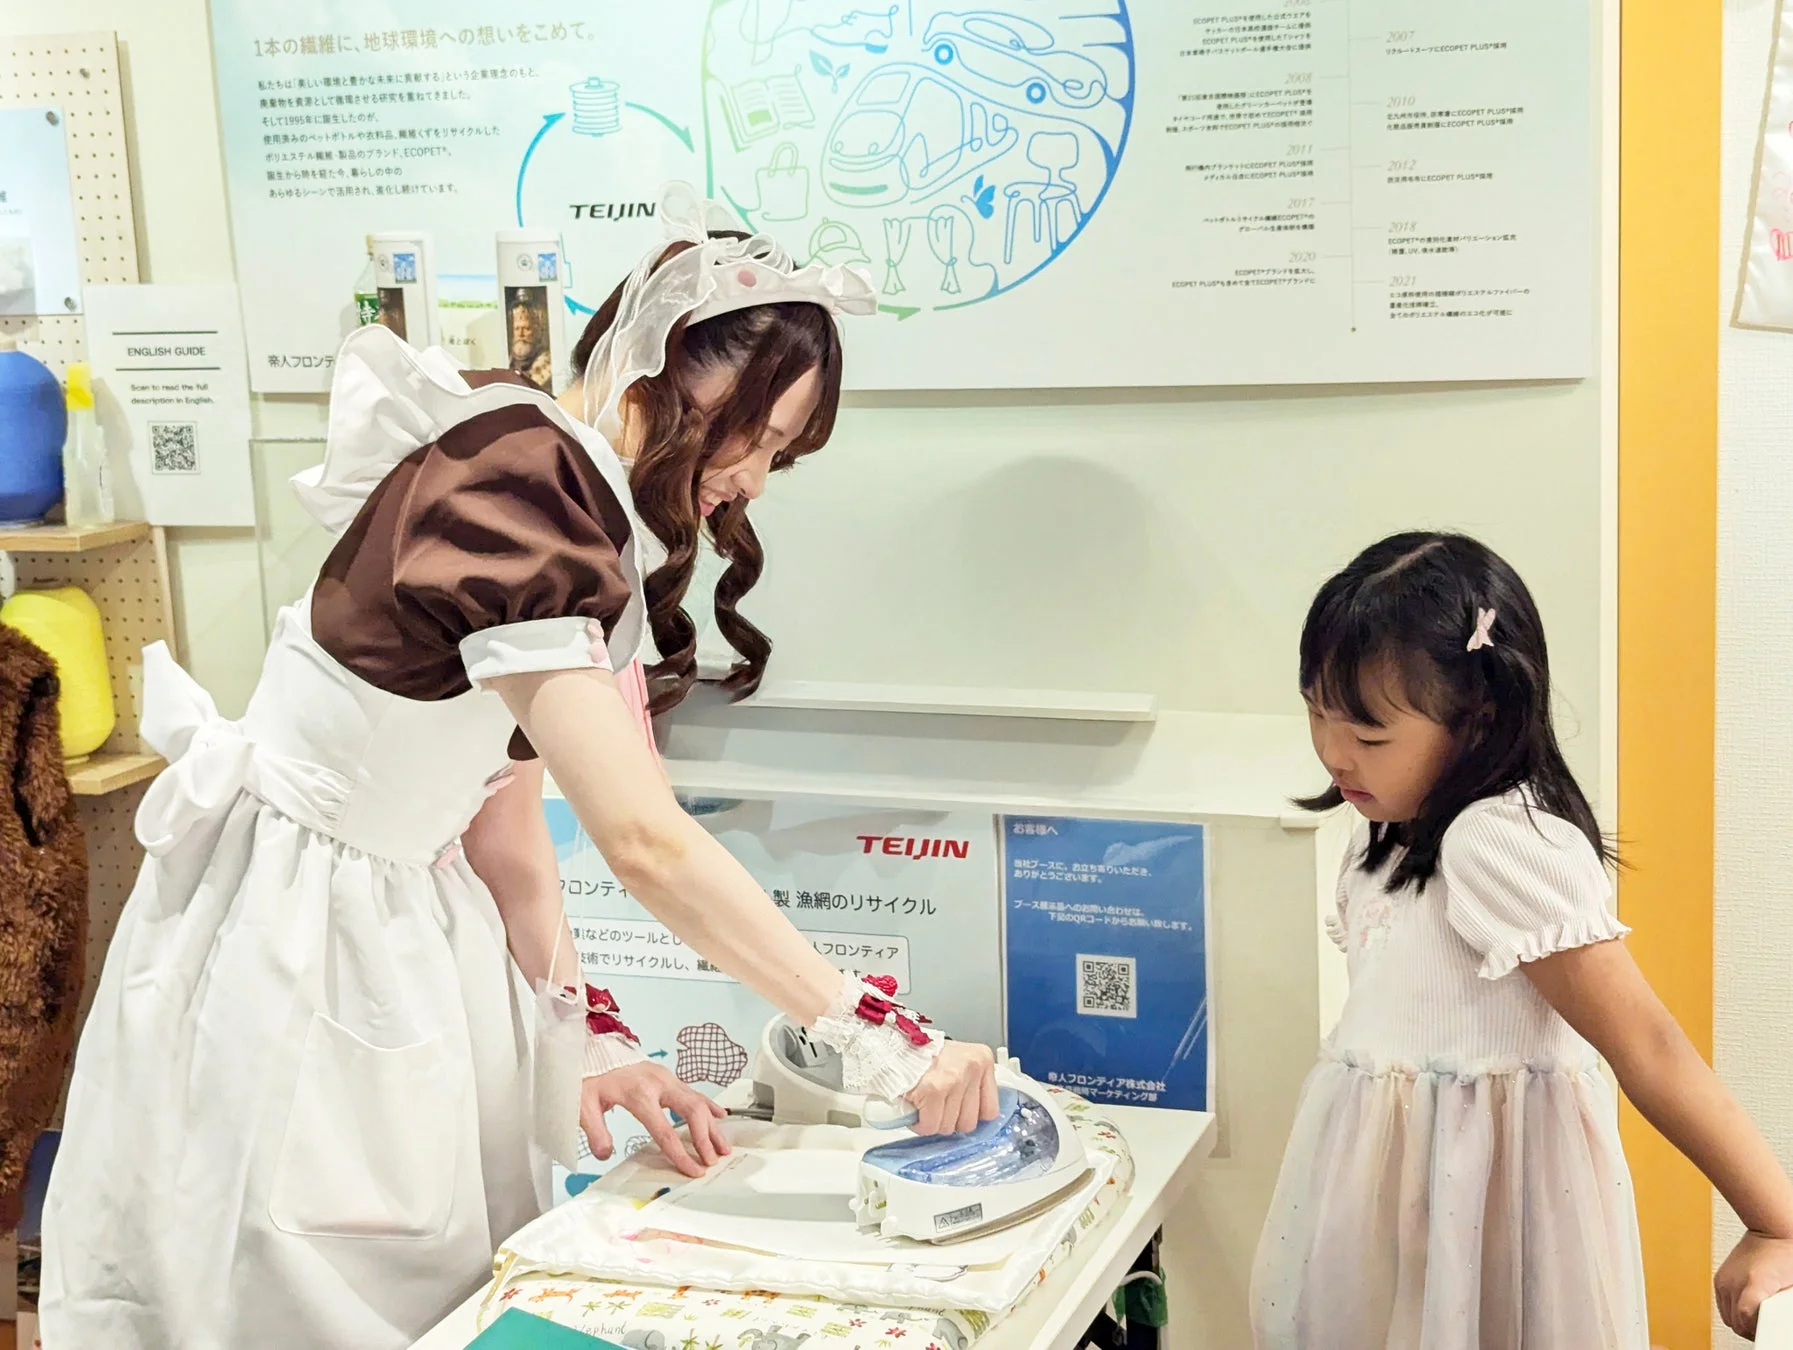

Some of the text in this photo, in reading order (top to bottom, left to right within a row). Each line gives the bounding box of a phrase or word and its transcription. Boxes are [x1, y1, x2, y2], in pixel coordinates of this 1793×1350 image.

[253, 22, 595, 57] 1本の繊維に、地球環境への想いをこめて。
[1386, 30, 1415, 43] 2007
[261, 113, 380, 128] そして1995年に誕生したのが、
[1387, 159, 1417, 171] 2012
[1287, 197, 1315, 209] 2017
[569, 202, 656, 221] TEIJIN
[1288, 251, 1316, 263] 2020
[1389, 275, 1417, 287] 2021
[127, 346, 206, 357] ENGLISH GUIDE
[131, 384, 149, 392] Scan
[181, 383, 193, 391] the
[196, 383, 208, 391] full
[131, 397, 175, 405] description
[185, 397, 215, 405] English.
[1013, 823, 1058, 836] お客様へ
[856, 835, 970, 860] TEIJIN
[796, 890, 937, 915] 漁網のリサイクル
